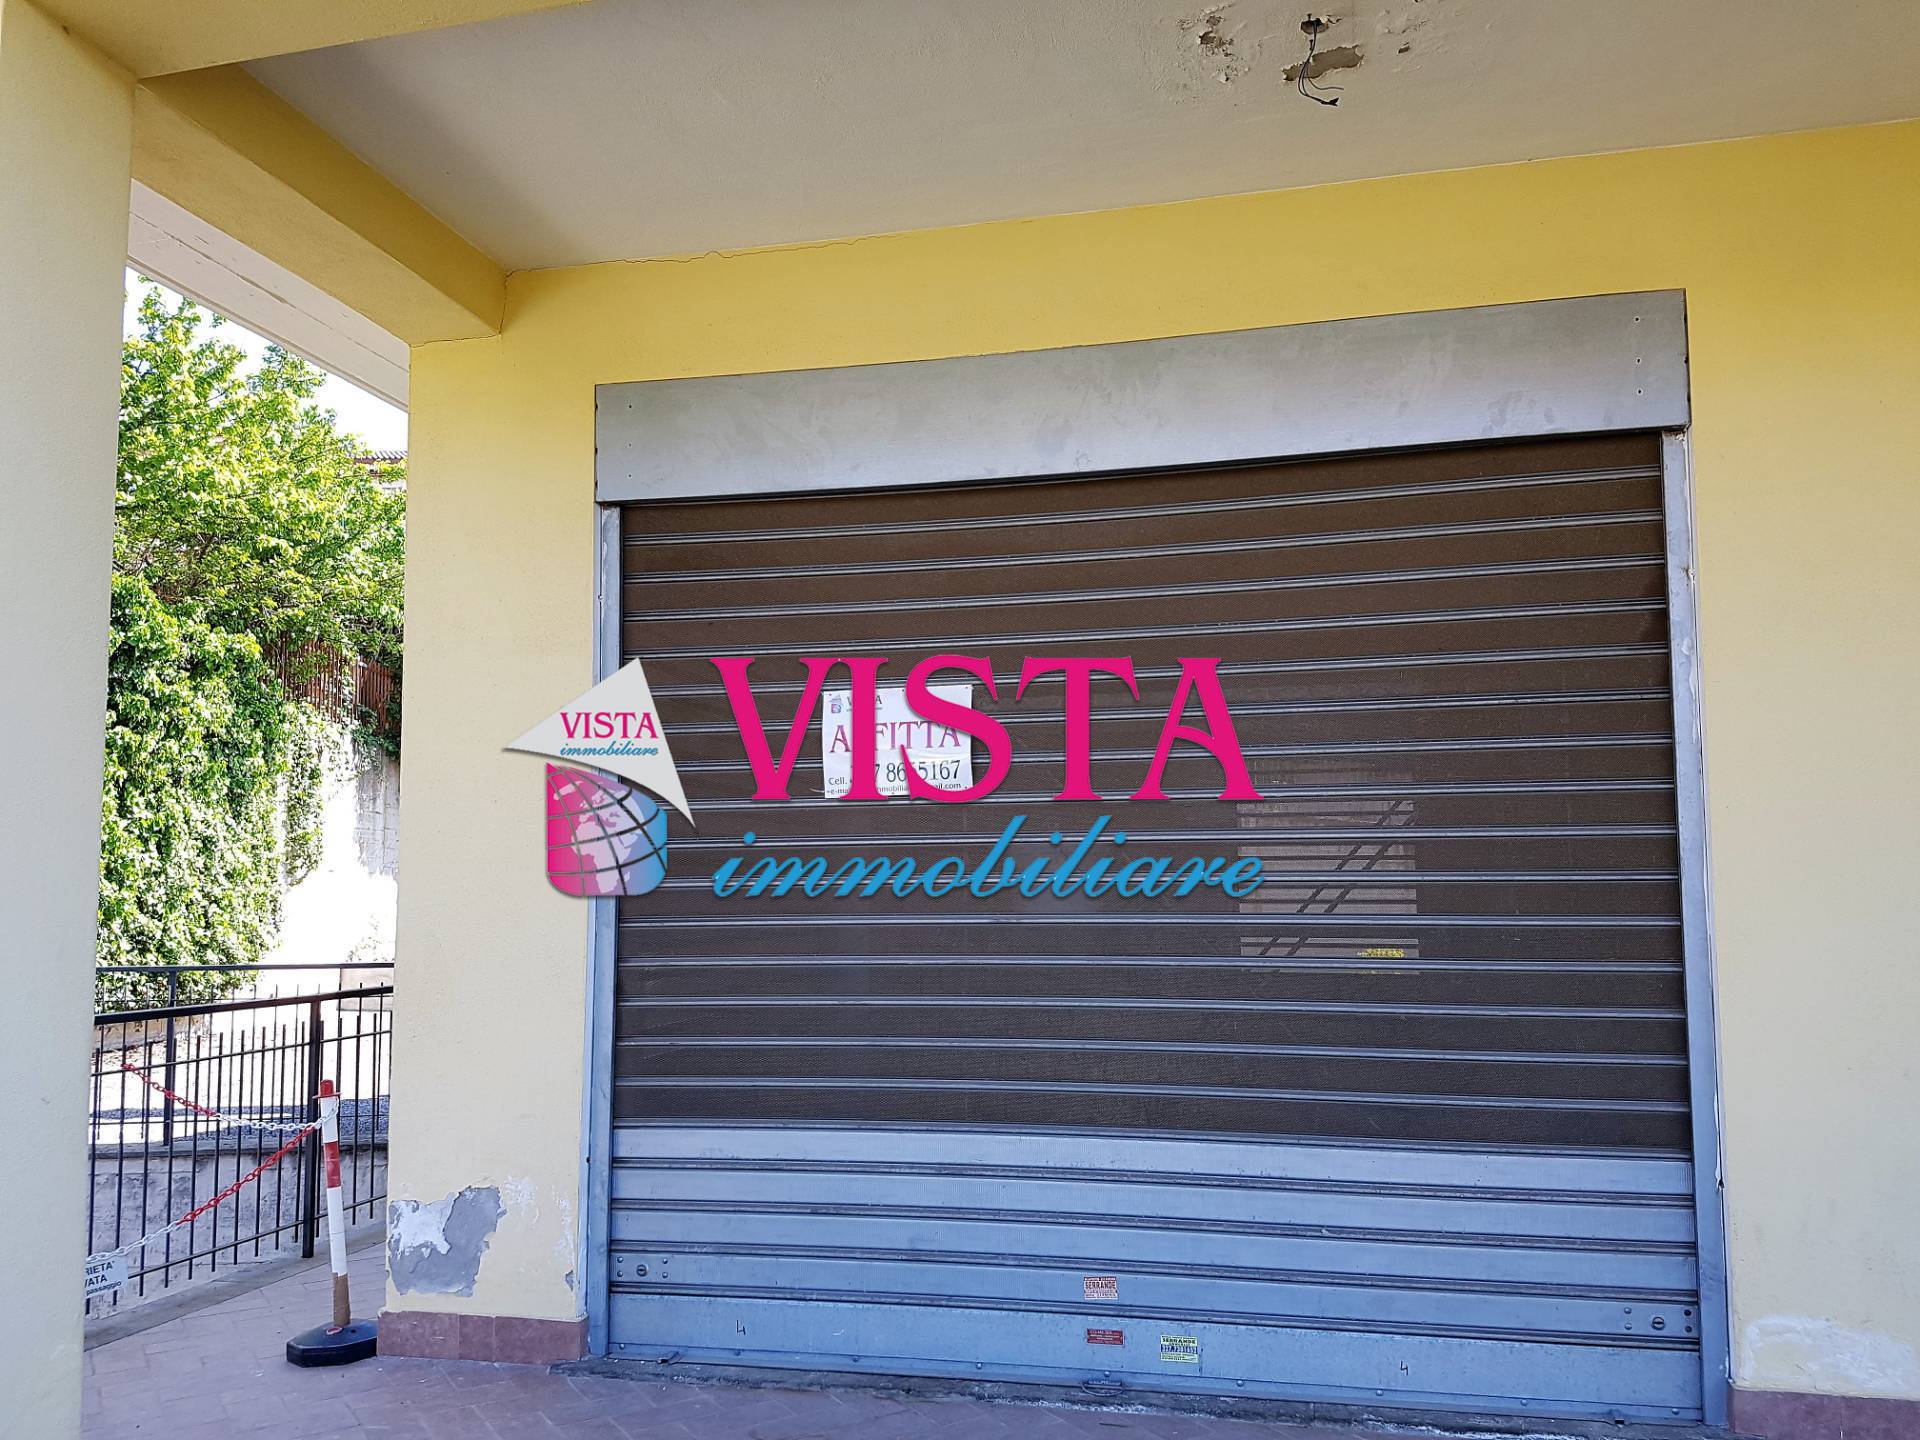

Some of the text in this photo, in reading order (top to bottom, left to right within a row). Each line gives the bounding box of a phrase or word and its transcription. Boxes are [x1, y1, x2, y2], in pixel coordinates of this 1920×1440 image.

[830, 721, 961, 753] AFITTA
[828, 777, 848, 786] Cell.
[886, 760, 961, 783] 865167
[1085, 1281, 1116, 1289] SERRANDE
